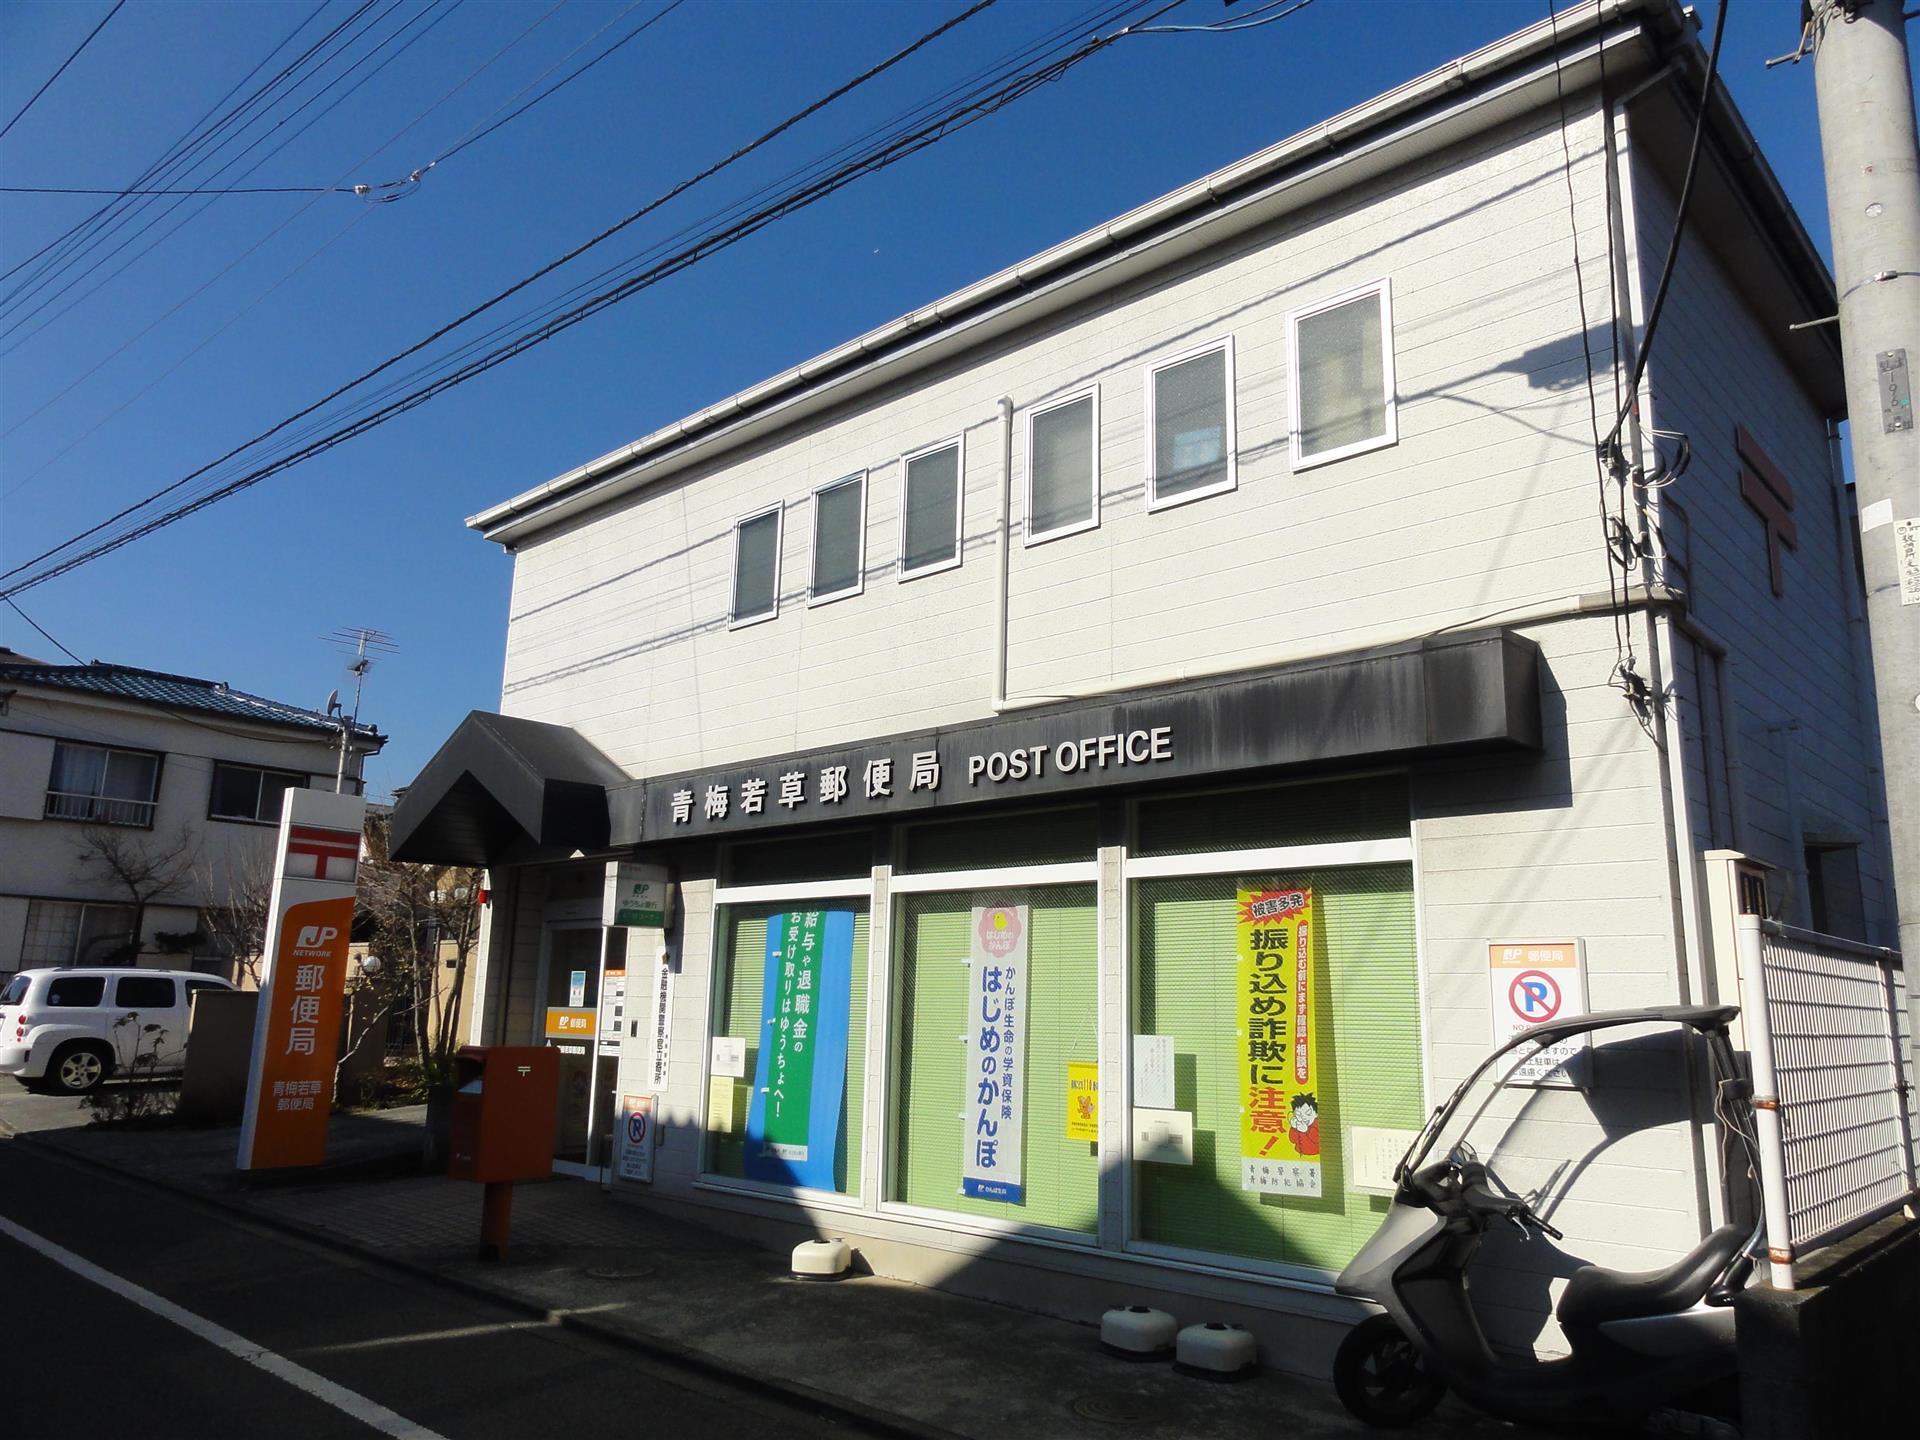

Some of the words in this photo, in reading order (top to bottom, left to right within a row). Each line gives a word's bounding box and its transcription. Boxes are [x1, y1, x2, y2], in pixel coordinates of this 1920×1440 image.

[968, 744, 1049, 785] POST
[1054, 725, 1173, 774] OFFICE
[670, 749, 942, 823] 青梅若草郵便局
[1252, 892, 1304, 918] 被害多発
[292, 948, 332, 958] NETWORK
[296, 926, 338, 948] JP
[1527, 950, 1564, 962] 郵便局
[285, 964, 324, 1056] 郵便局
[793, 911, 820, 1053] 給与や退職金の
[976, 966, 1002, 1169] はじめのかんぽ
[1001, 966, 1016, 1120] かんぽ生命の学資保険
[1247, 928, 1289, 1156] 振り込め詐欺に注意！
[272, 1080, 322, 1097] 青梅若草
[276, 1097, 314, 1111] 郵便局
